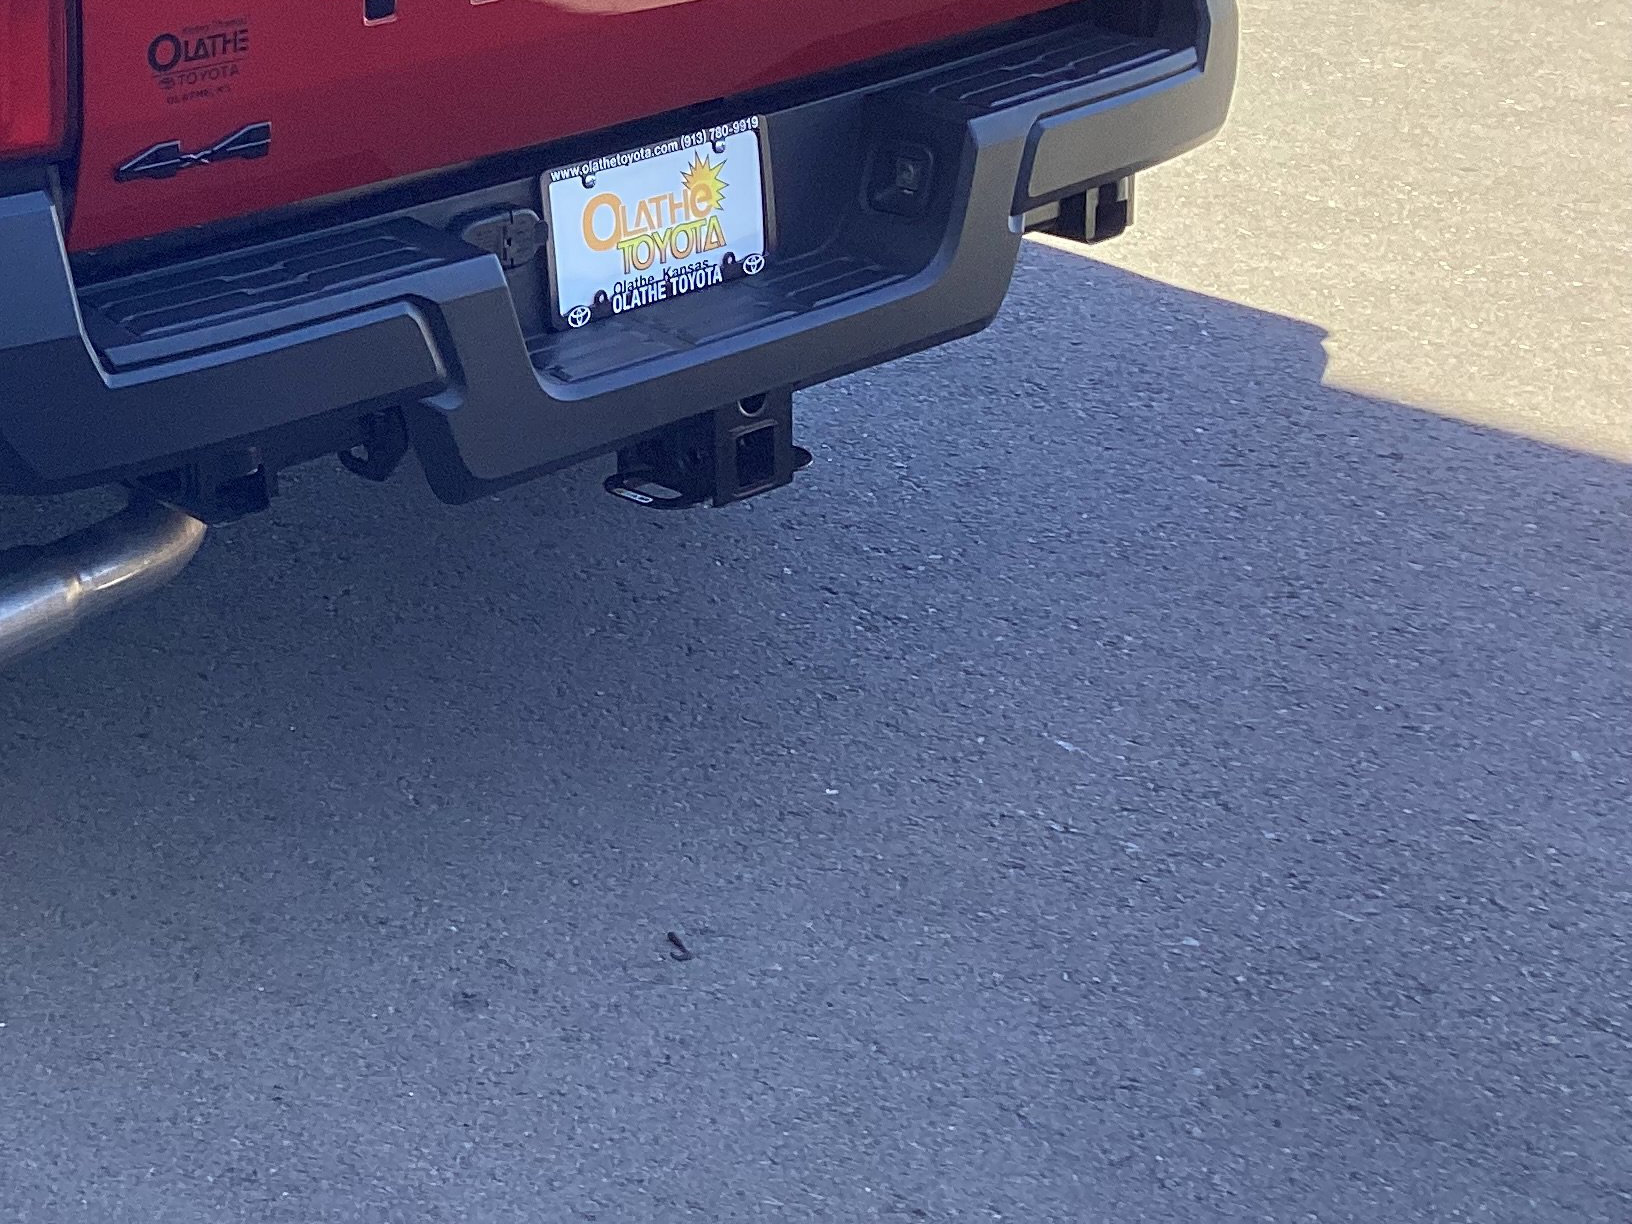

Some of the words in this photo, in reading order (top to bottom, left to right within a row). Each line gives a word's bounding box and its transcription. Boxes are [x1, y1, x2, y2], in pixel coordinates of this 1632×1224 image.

[147, 30, 248, 72] OLATHE
[178, 64, 240, 86] TOYOTA
[551, 140, 678, 182] www.olathetoyota.com
[681, 128, 707, 150] (913)
[709, 115, 759, 140] 780-9919
[617, 215, 727, 274] TOYOTA
[612, 280, 667, 314] OLATHE
[670, 265, 723, 296] TOYOTA
